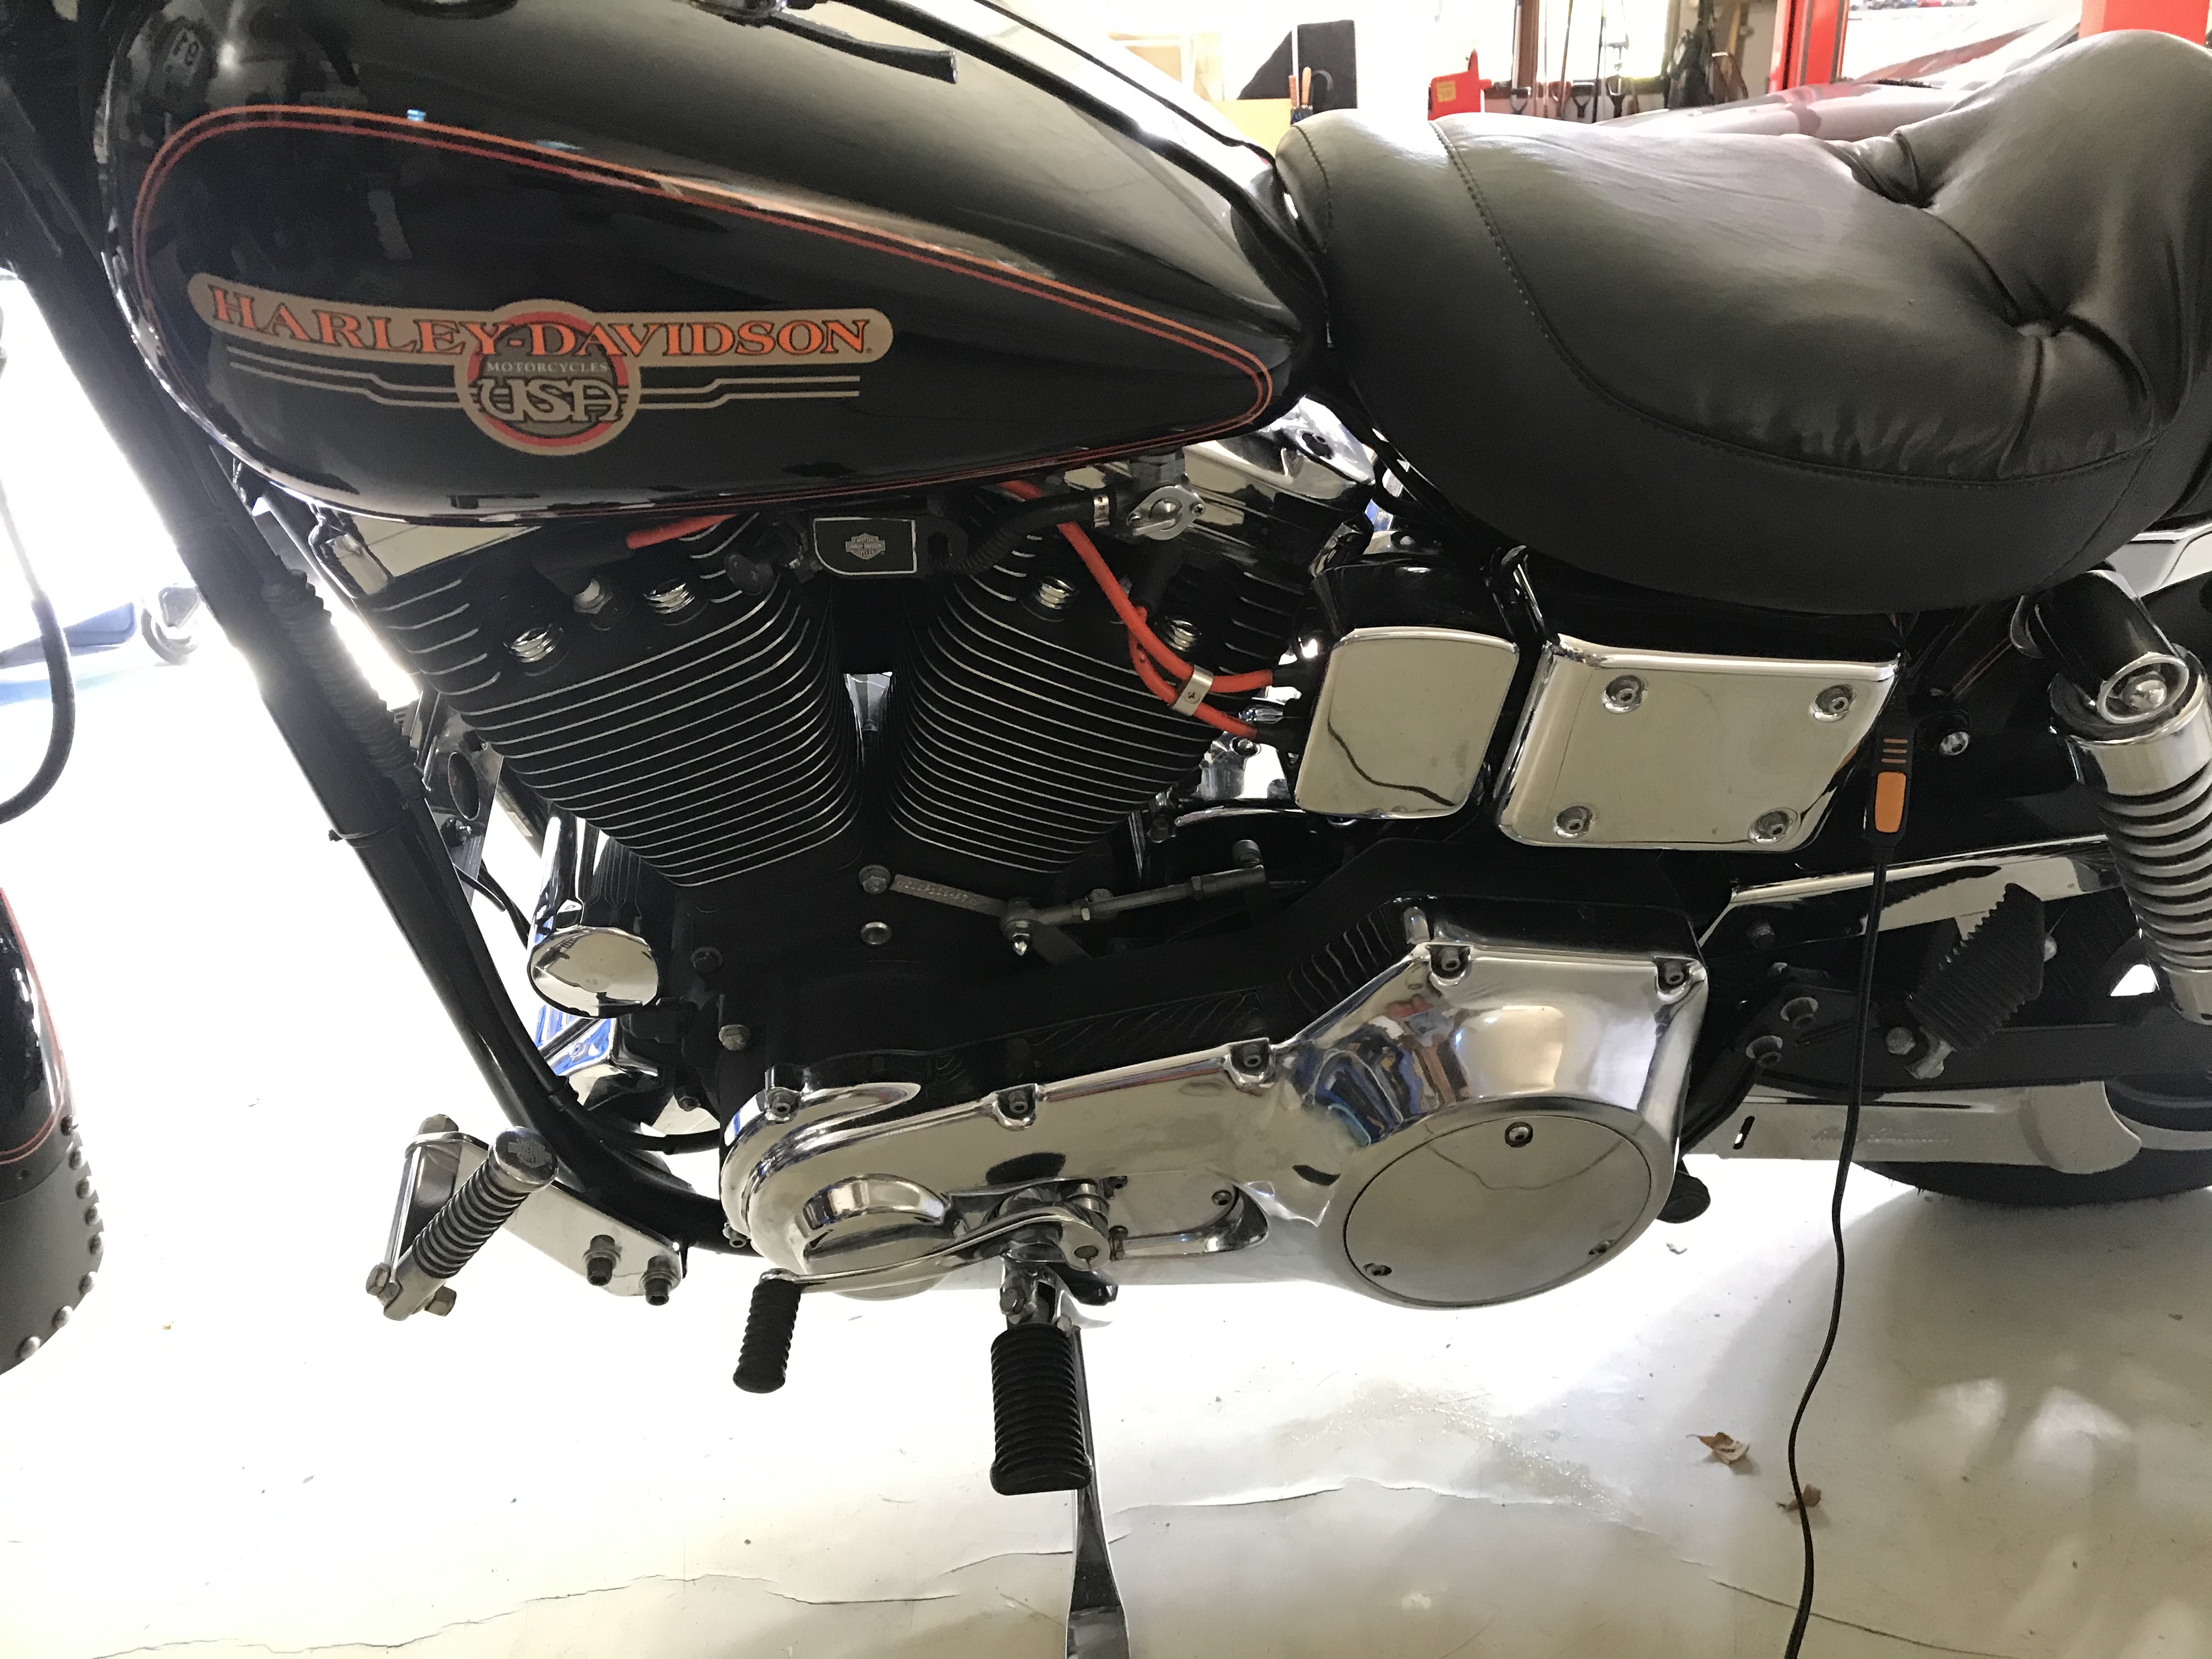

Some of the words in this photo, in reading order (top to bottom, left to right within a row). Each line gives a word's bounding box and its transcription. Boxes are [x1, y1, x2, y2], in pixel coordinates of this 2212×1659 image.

[207, 284, 871, 357] HARLEY-DAVIDSON
[486, 361, 609, 374] MOTORCYCLES
[477, 377, 622, 422] USA
